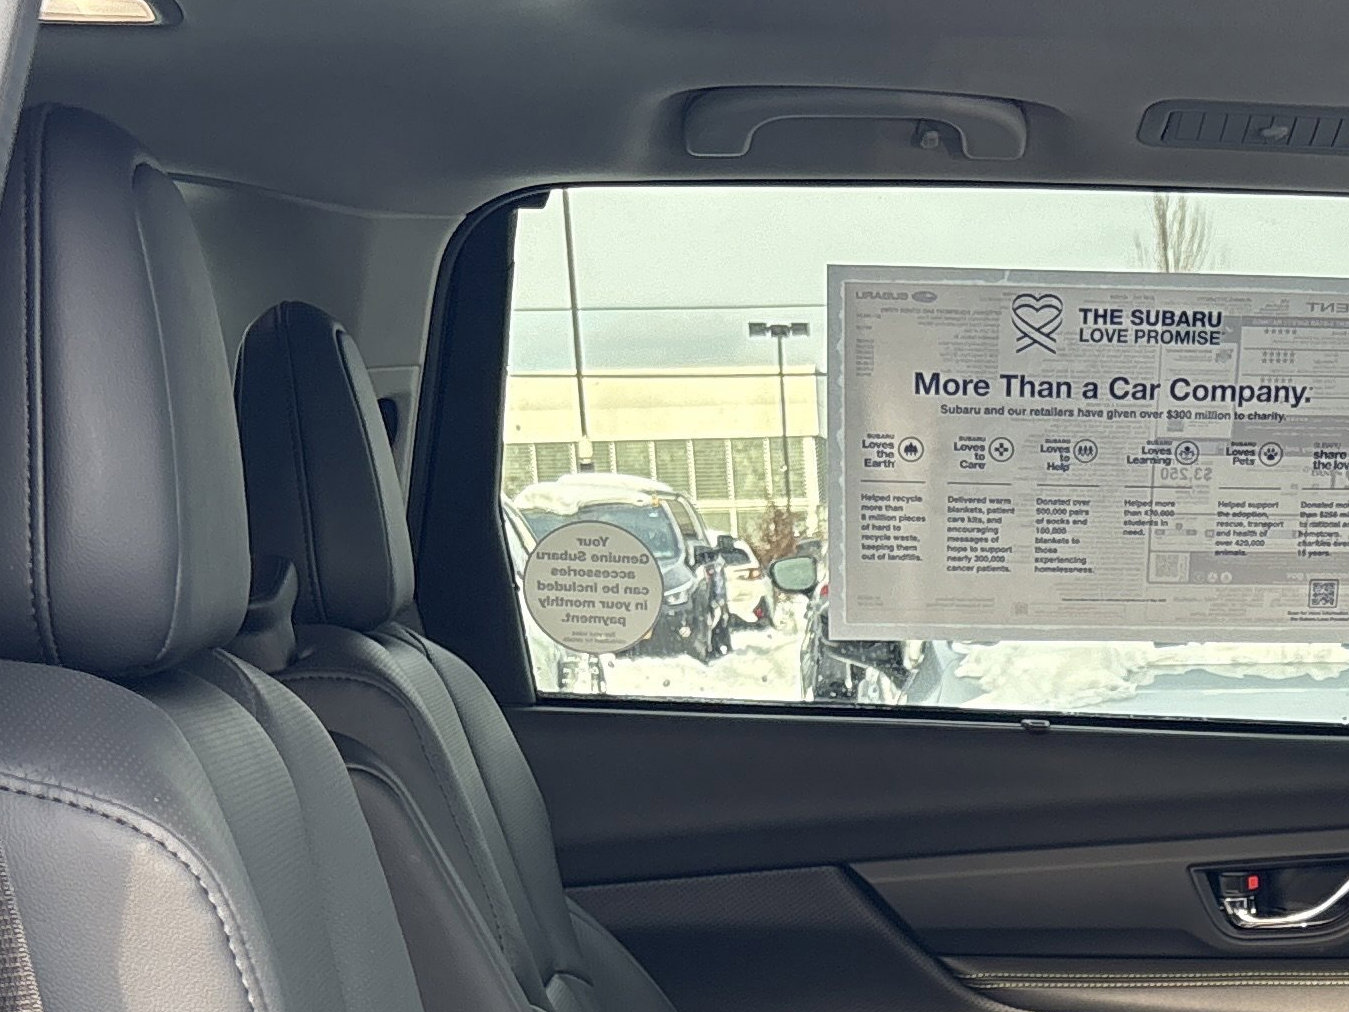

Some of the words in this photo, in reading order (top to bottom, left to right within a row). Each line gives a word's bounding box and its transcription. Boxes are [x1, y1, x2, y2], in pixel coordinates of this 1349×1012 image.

[1079, 308, 1123, 325] THE
[1130, 310, 1222, 327] SUBARU
[1079, 328, 1128, 343] LOVE
[1134, 330, 1222, 345] PROMISE
[914, 372, 990, 396] More
[1000, 374, 1072, 399] Than
[1083, 381, 1098, 399] a
[1109, 376, 1161, 400] Car
[1170, 377, 1311, 408] Company.
[941, 404, 980, 416] Subaru
[984, 405, 1005, 416] and
[1007, 407, 1027, 416] our
[1029, 405, 1074, 417] retailers
[1077, 407, 1103, 418] have
[1106, 408, 1137, 420] given
[1140, 411, 1163, 419] over
[1166, 409, 1192, 420] $300
[1195, 409, 1231, 420] million
[1234, 411, 1245, 420] to
[1247, 411, 1287, 423] charity.
[862, 439, 894, 449] Loves
[954, 442, 985, 451] Loves
[1040, 444, 1070, 453] Loves
[877, 450, 894, 458] the
[1142, 446, 1172, 455] Loves
[1226, 447, 1255, 456] Loves
[1313, 450, 1347, 459] share
[974, 452, 985, 460] to
[1060, 454, 1070, 462] to
[1127, 455, 1172, 466] Learning
[864, 459, 895, 468] Earth
[960, 460, 986, 469] Care
[1233, 457, 1256, 465] Pets
[1313, 460, 1332, 470] the
[1047, 462, 1070, 472] Help
[861, 494, 890, 502] Helped
[893, 495, 922, 504] recycle
[948, 496, 986, 504] Delivered
[1036, 498, 1071, 506] Donated
[1124, 500, 1152, 508] Helped
[1218, 501, 1246, 510] Helped
[1248, 502, 1279, 510] support
[947, 506, 985, 514] blankets,
[986, 507, 1015, 515] patient
[1069, 509, 1089, 517] pairs
[1232, 511, 1269, 519] adoption,
[899, 514, 926, 523] pieces
[1035, 517, 1044, 525] of
[947, 526, 999, 535] encouraging
[861, 534, 891, 542] recycle
[861, 543, 894, 552] keeping
[947, 545, 967, 553] hope
[947, 555, 972, 563] nearly
[1034, 556, 1087, 565] experiencing
[976, 565, 1011, 574] patients.
[1034, 565, 1095, 573] homelessness.
